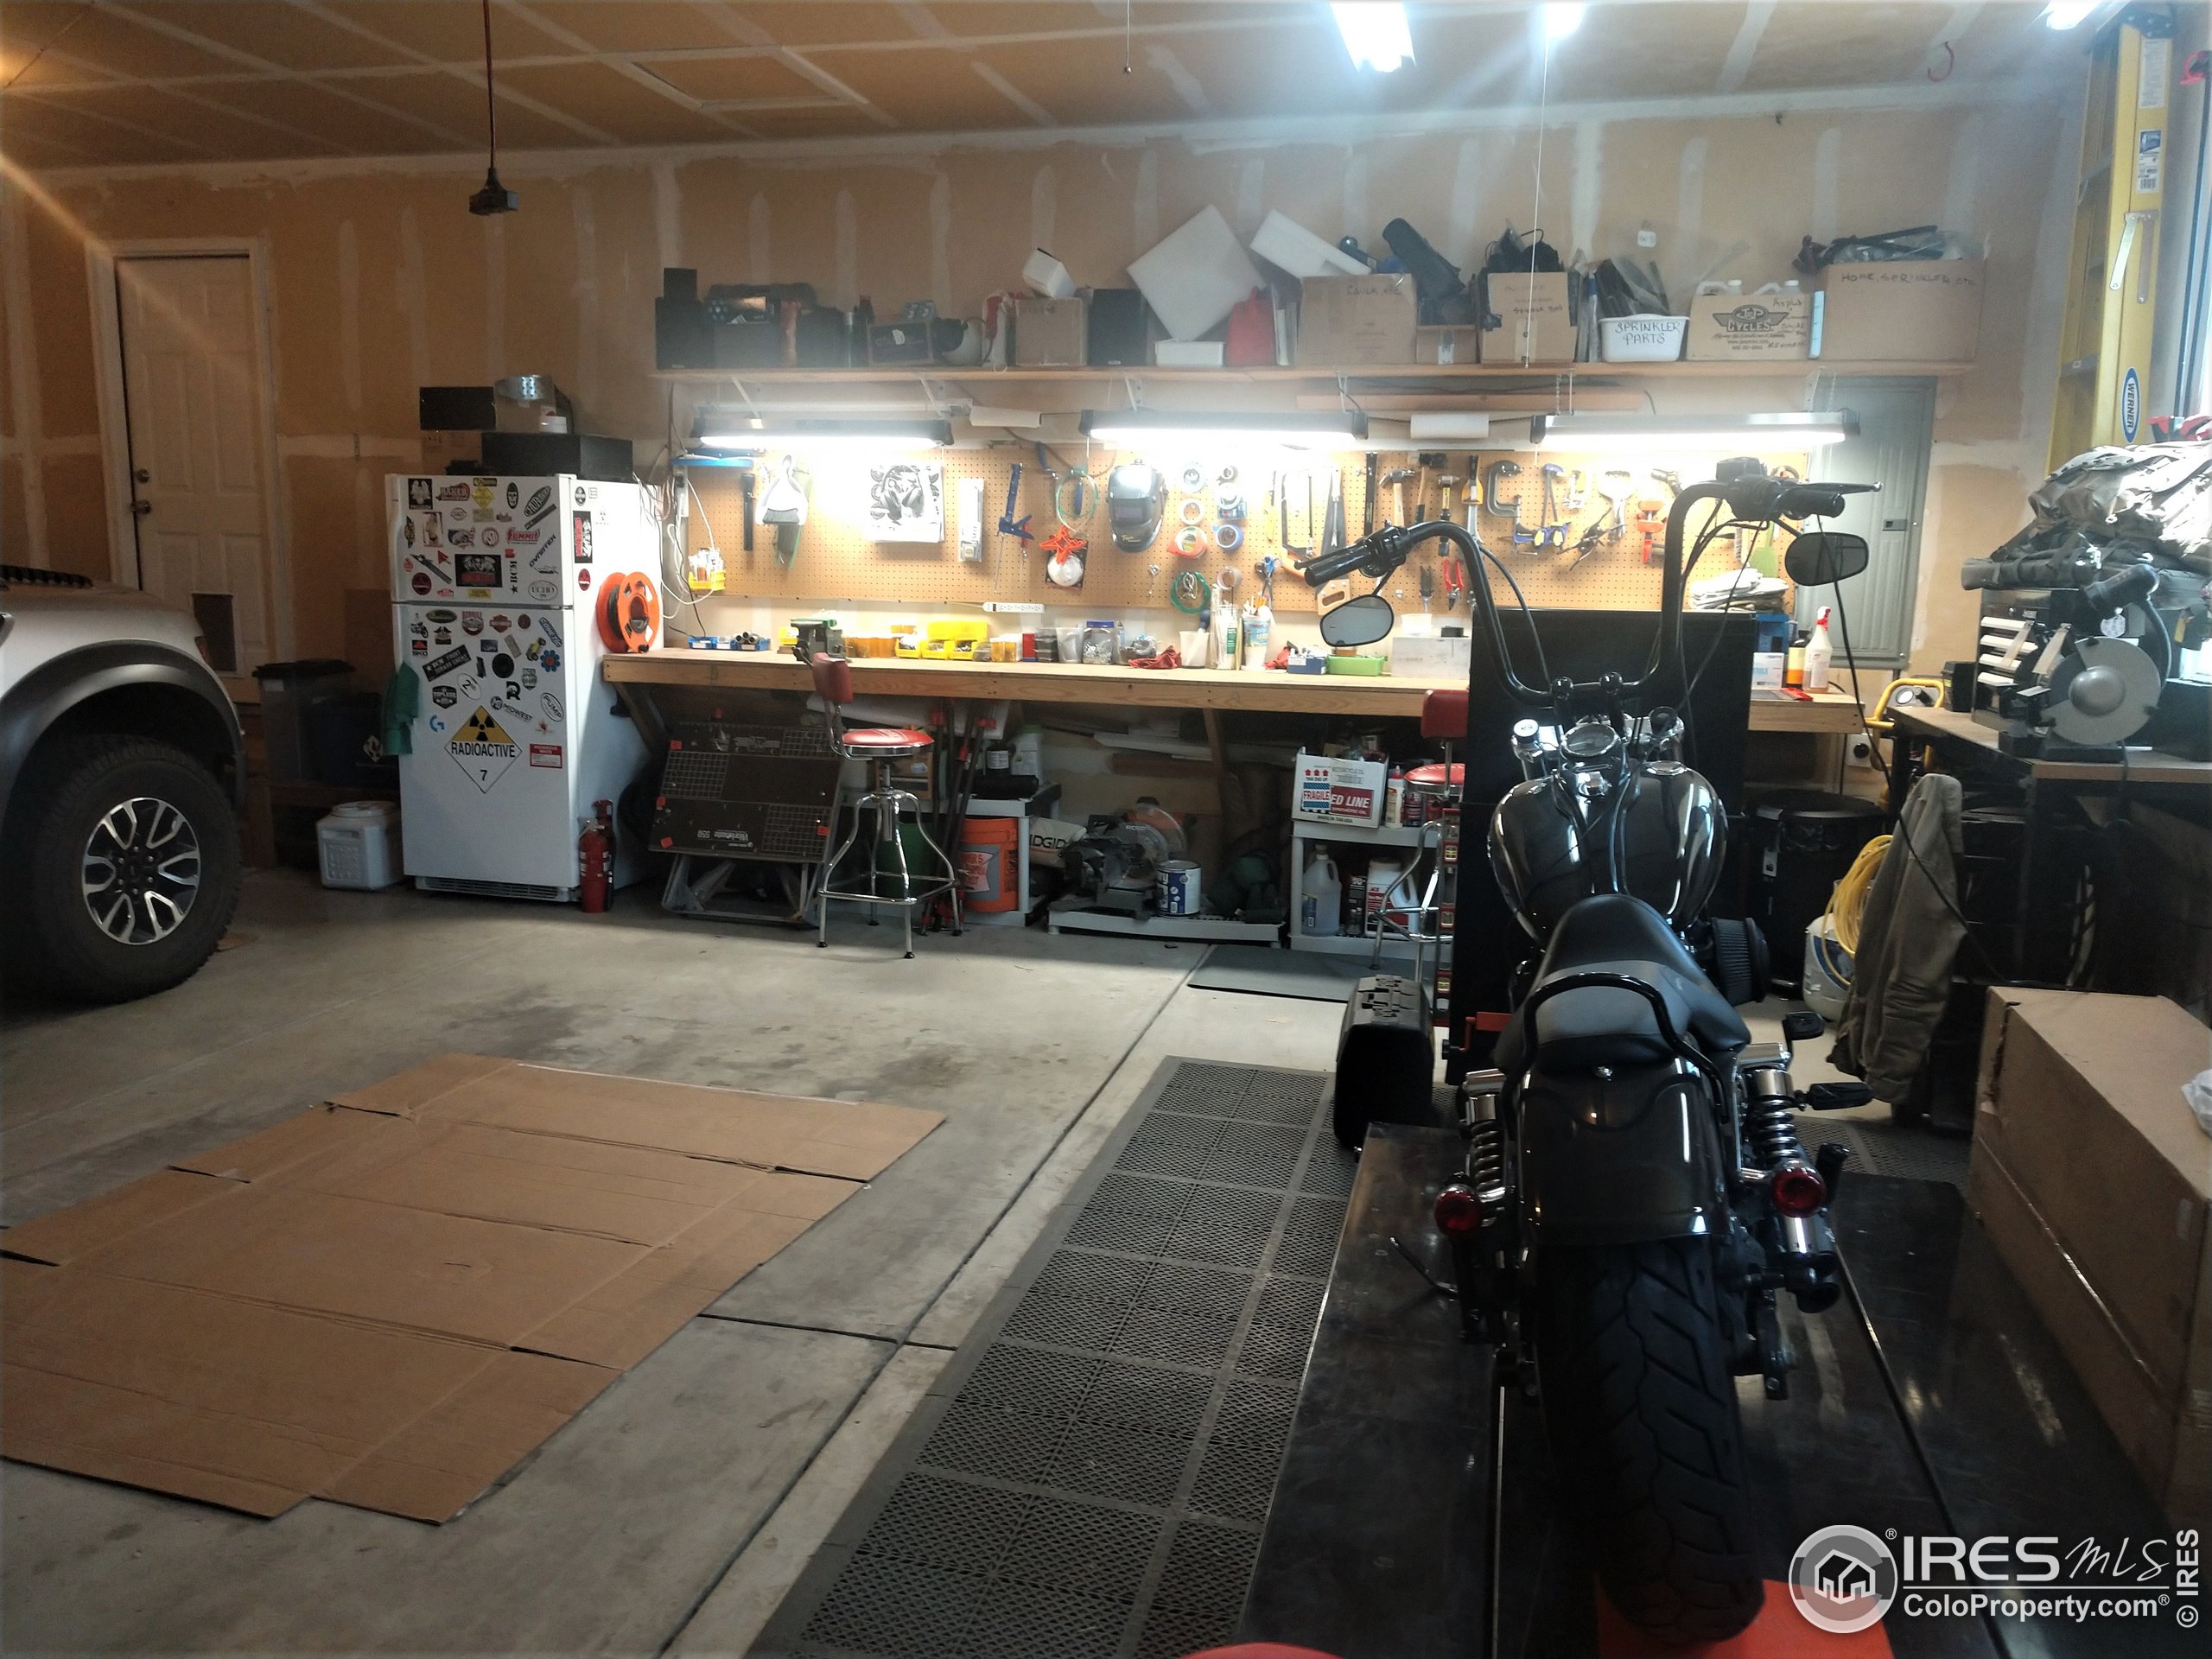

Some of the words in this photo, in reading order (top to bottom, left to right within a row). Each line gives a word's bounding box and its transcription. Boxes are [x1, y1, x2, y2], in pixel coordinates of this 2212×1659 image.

[1614, 321, 1681, 334] SPRINKLER
[1727, 319, 1771, 332] CYCLES
[1623, 333, 1666, 346] PARTS
[2126, 383, 2135, 429] WERNER
[543, 695, 563, 719] PUMP
[451, 742, 516, 758] RADIOACTIVE
[480, 769, 488, 781] 7
[1303, 790, 1331, 800] FRAGILE
[1332, 794, 1344, 805] ED
[1345, 795, 1371, 809] LINE
[1029, 833, 1067, 849] IDGID
